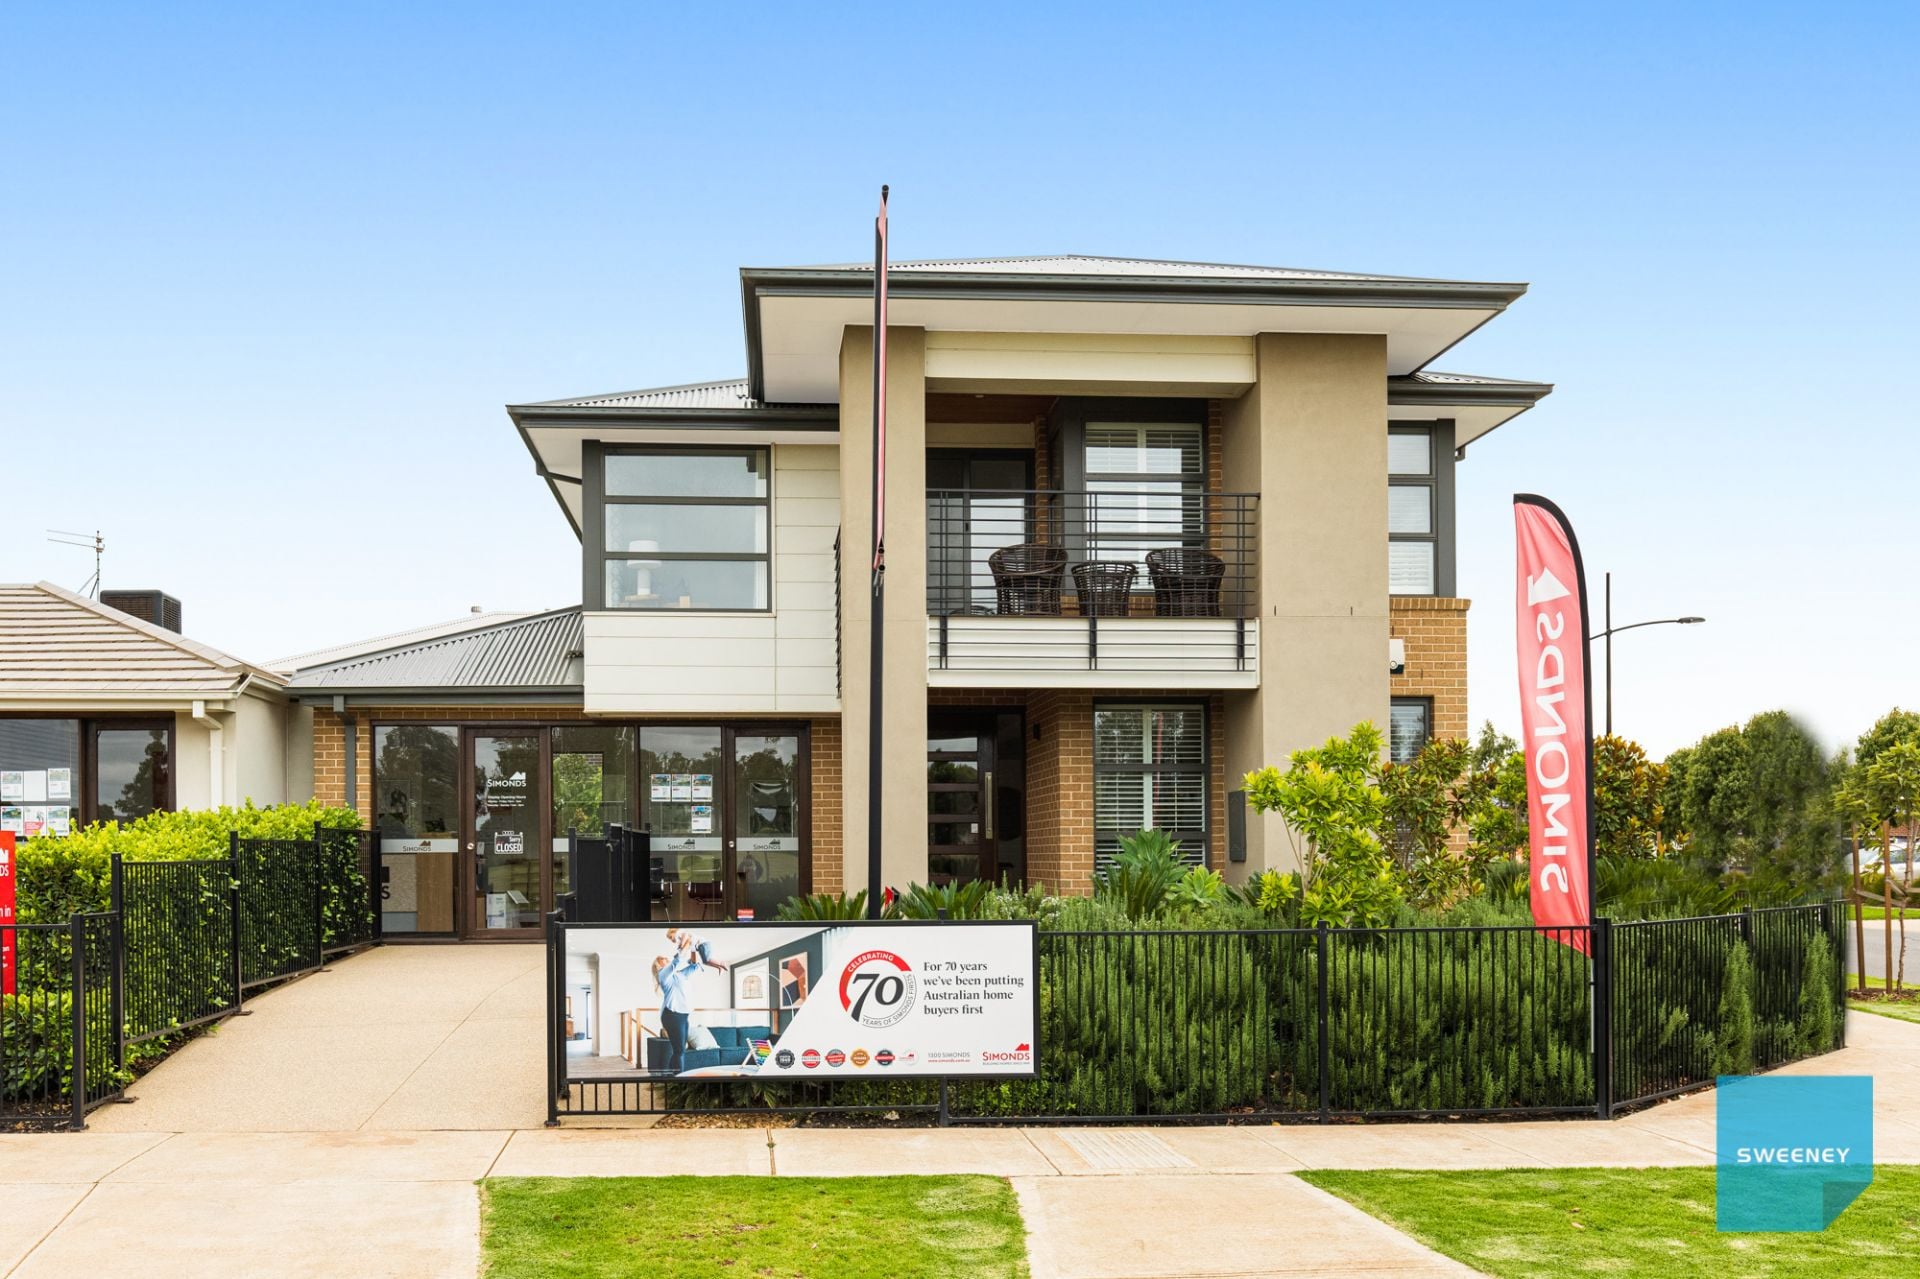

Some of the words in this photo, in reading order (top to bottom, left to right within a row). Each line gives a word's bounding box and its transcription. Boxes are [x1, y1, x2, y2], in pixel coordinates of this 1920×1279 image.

[496, 843, 522, 852] CLOSED
[847, 952, 894, 973] CELEBRATING
[923, 962, 942, 971] For
[945, 962, 957, 971] 70
[960, 963, 988, 973] years
[923, 977, 952, 986] we've
[956, 976, 981, 986] been
[984, 976, 1024, 988] putting
[851, 973, 904, 1022] 70
[924, 990, 980, 1000] Australian
[984, 990, 1014, 1000] home
[862, 1018, 882, 1026] YEARS
[892, 996, 914, 1022] SIMONDS
[924, 1004, 959, 1017] buyers
[962, 1004, 983, 1014] first
[982, 1051, 1030, 1061] SIMONDS
